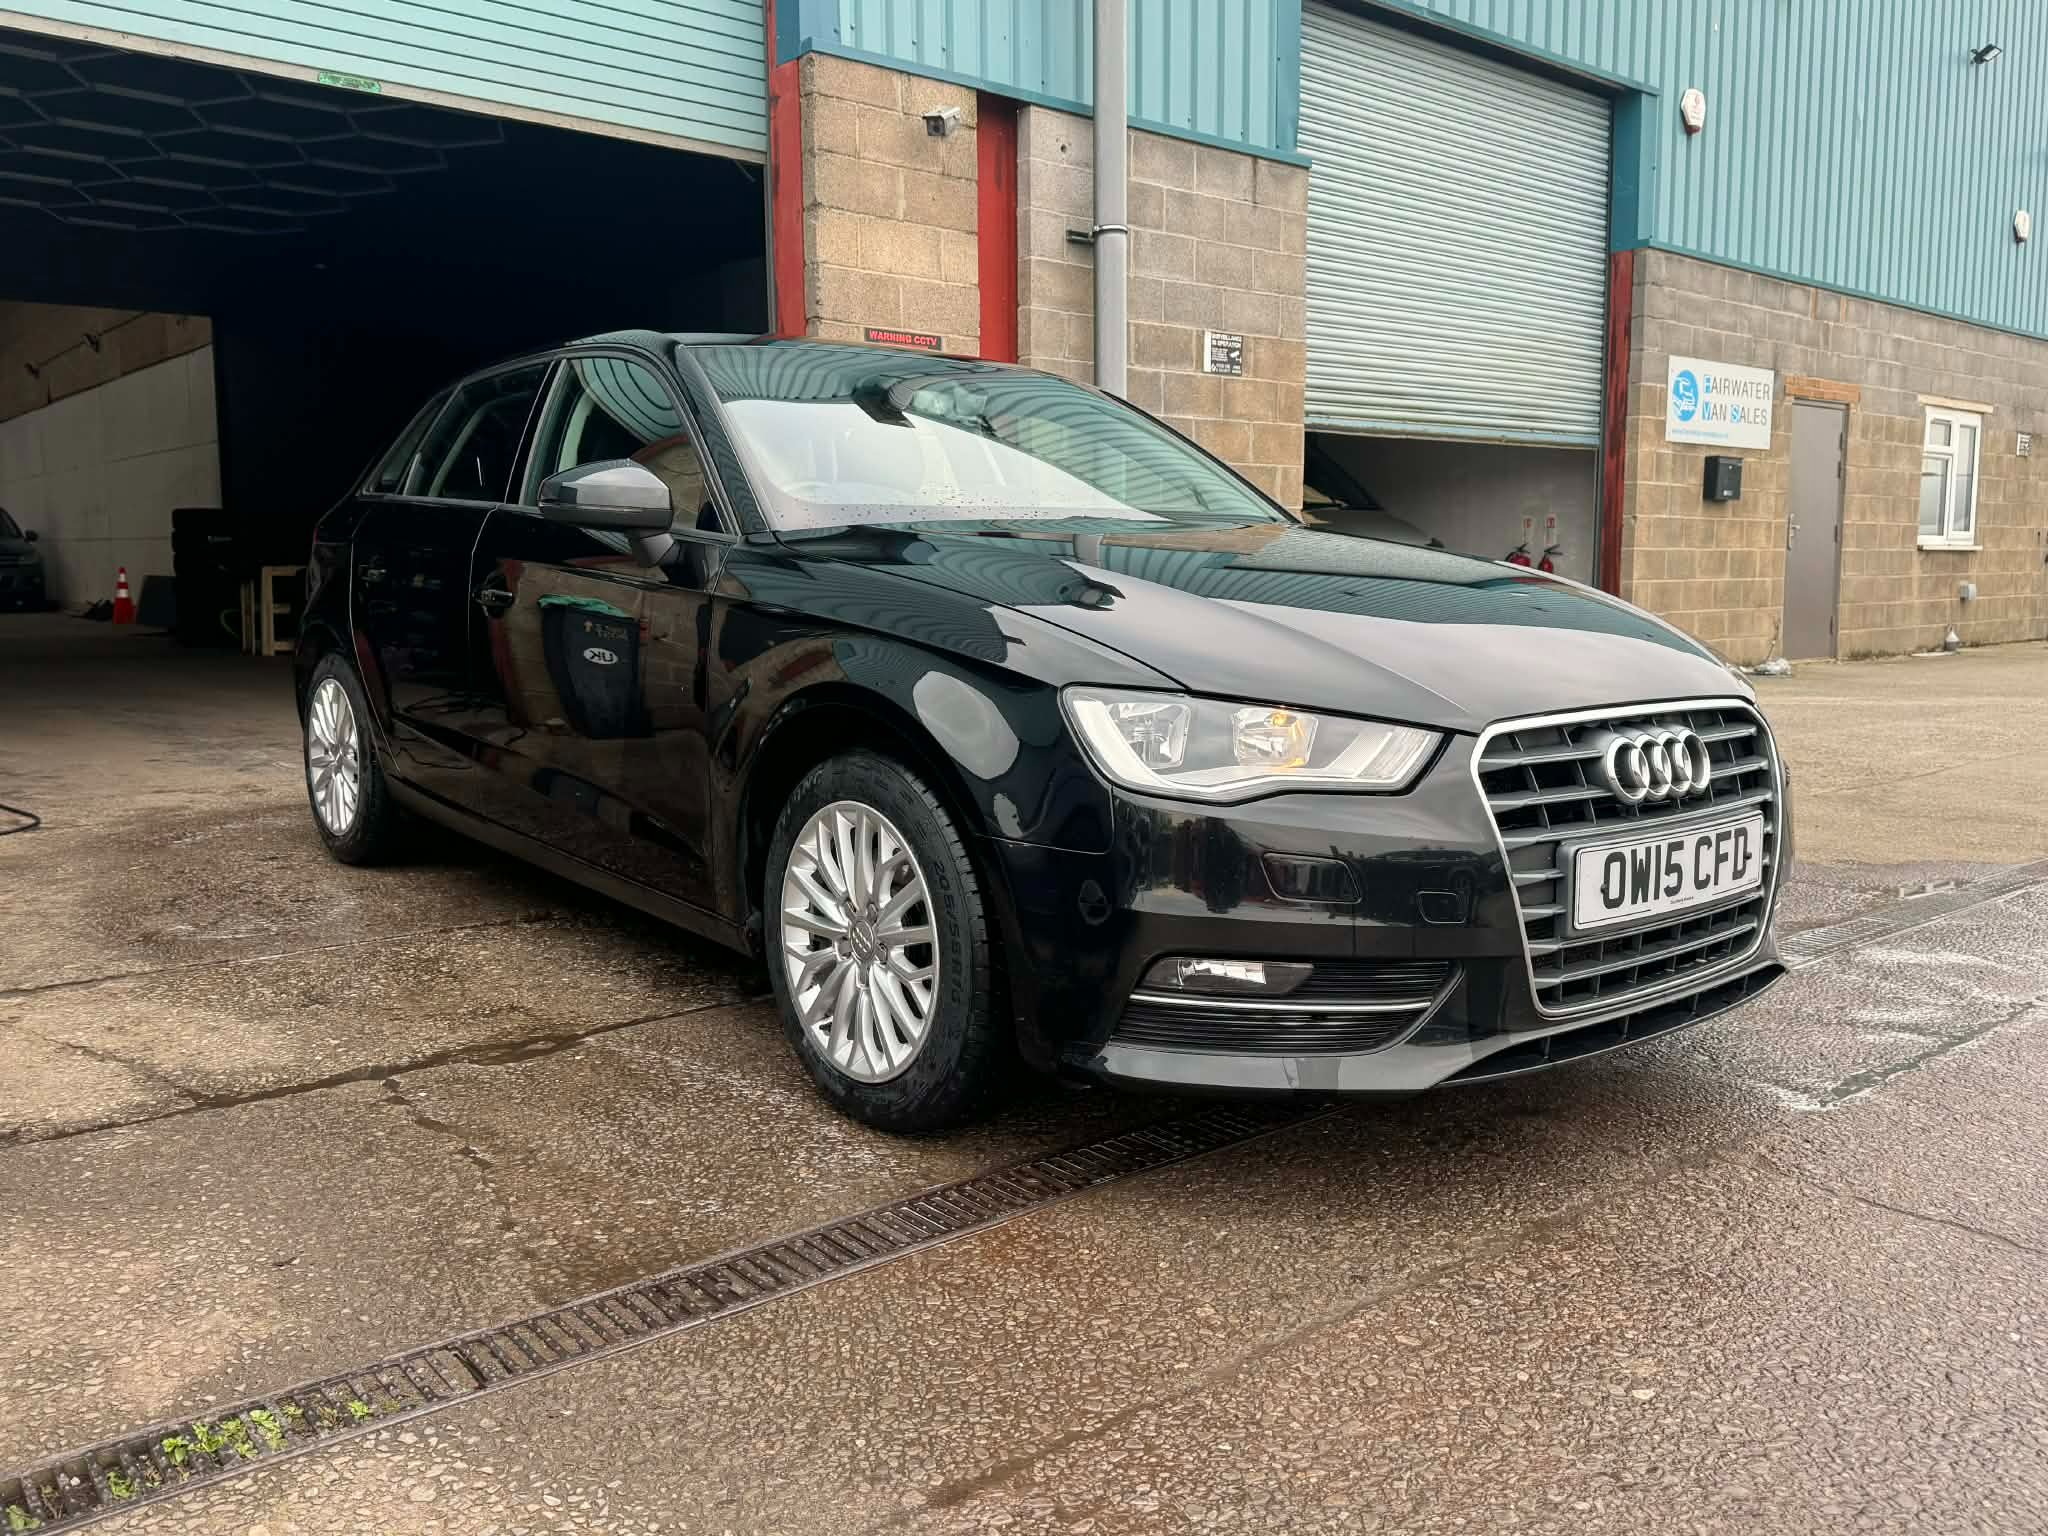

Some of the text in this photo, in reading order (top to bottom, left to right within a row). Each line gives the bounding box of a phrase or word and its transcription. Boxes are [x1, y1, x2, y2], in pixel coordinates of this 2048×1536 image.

[868, 330, 937, 346] WARNING CCTV
[1703, 374, 1770, 400] FAIRWATER
[1702, 401, 1768, 426] VAN SALES
[1602, 826, 1752, 909] OW15 CFD
